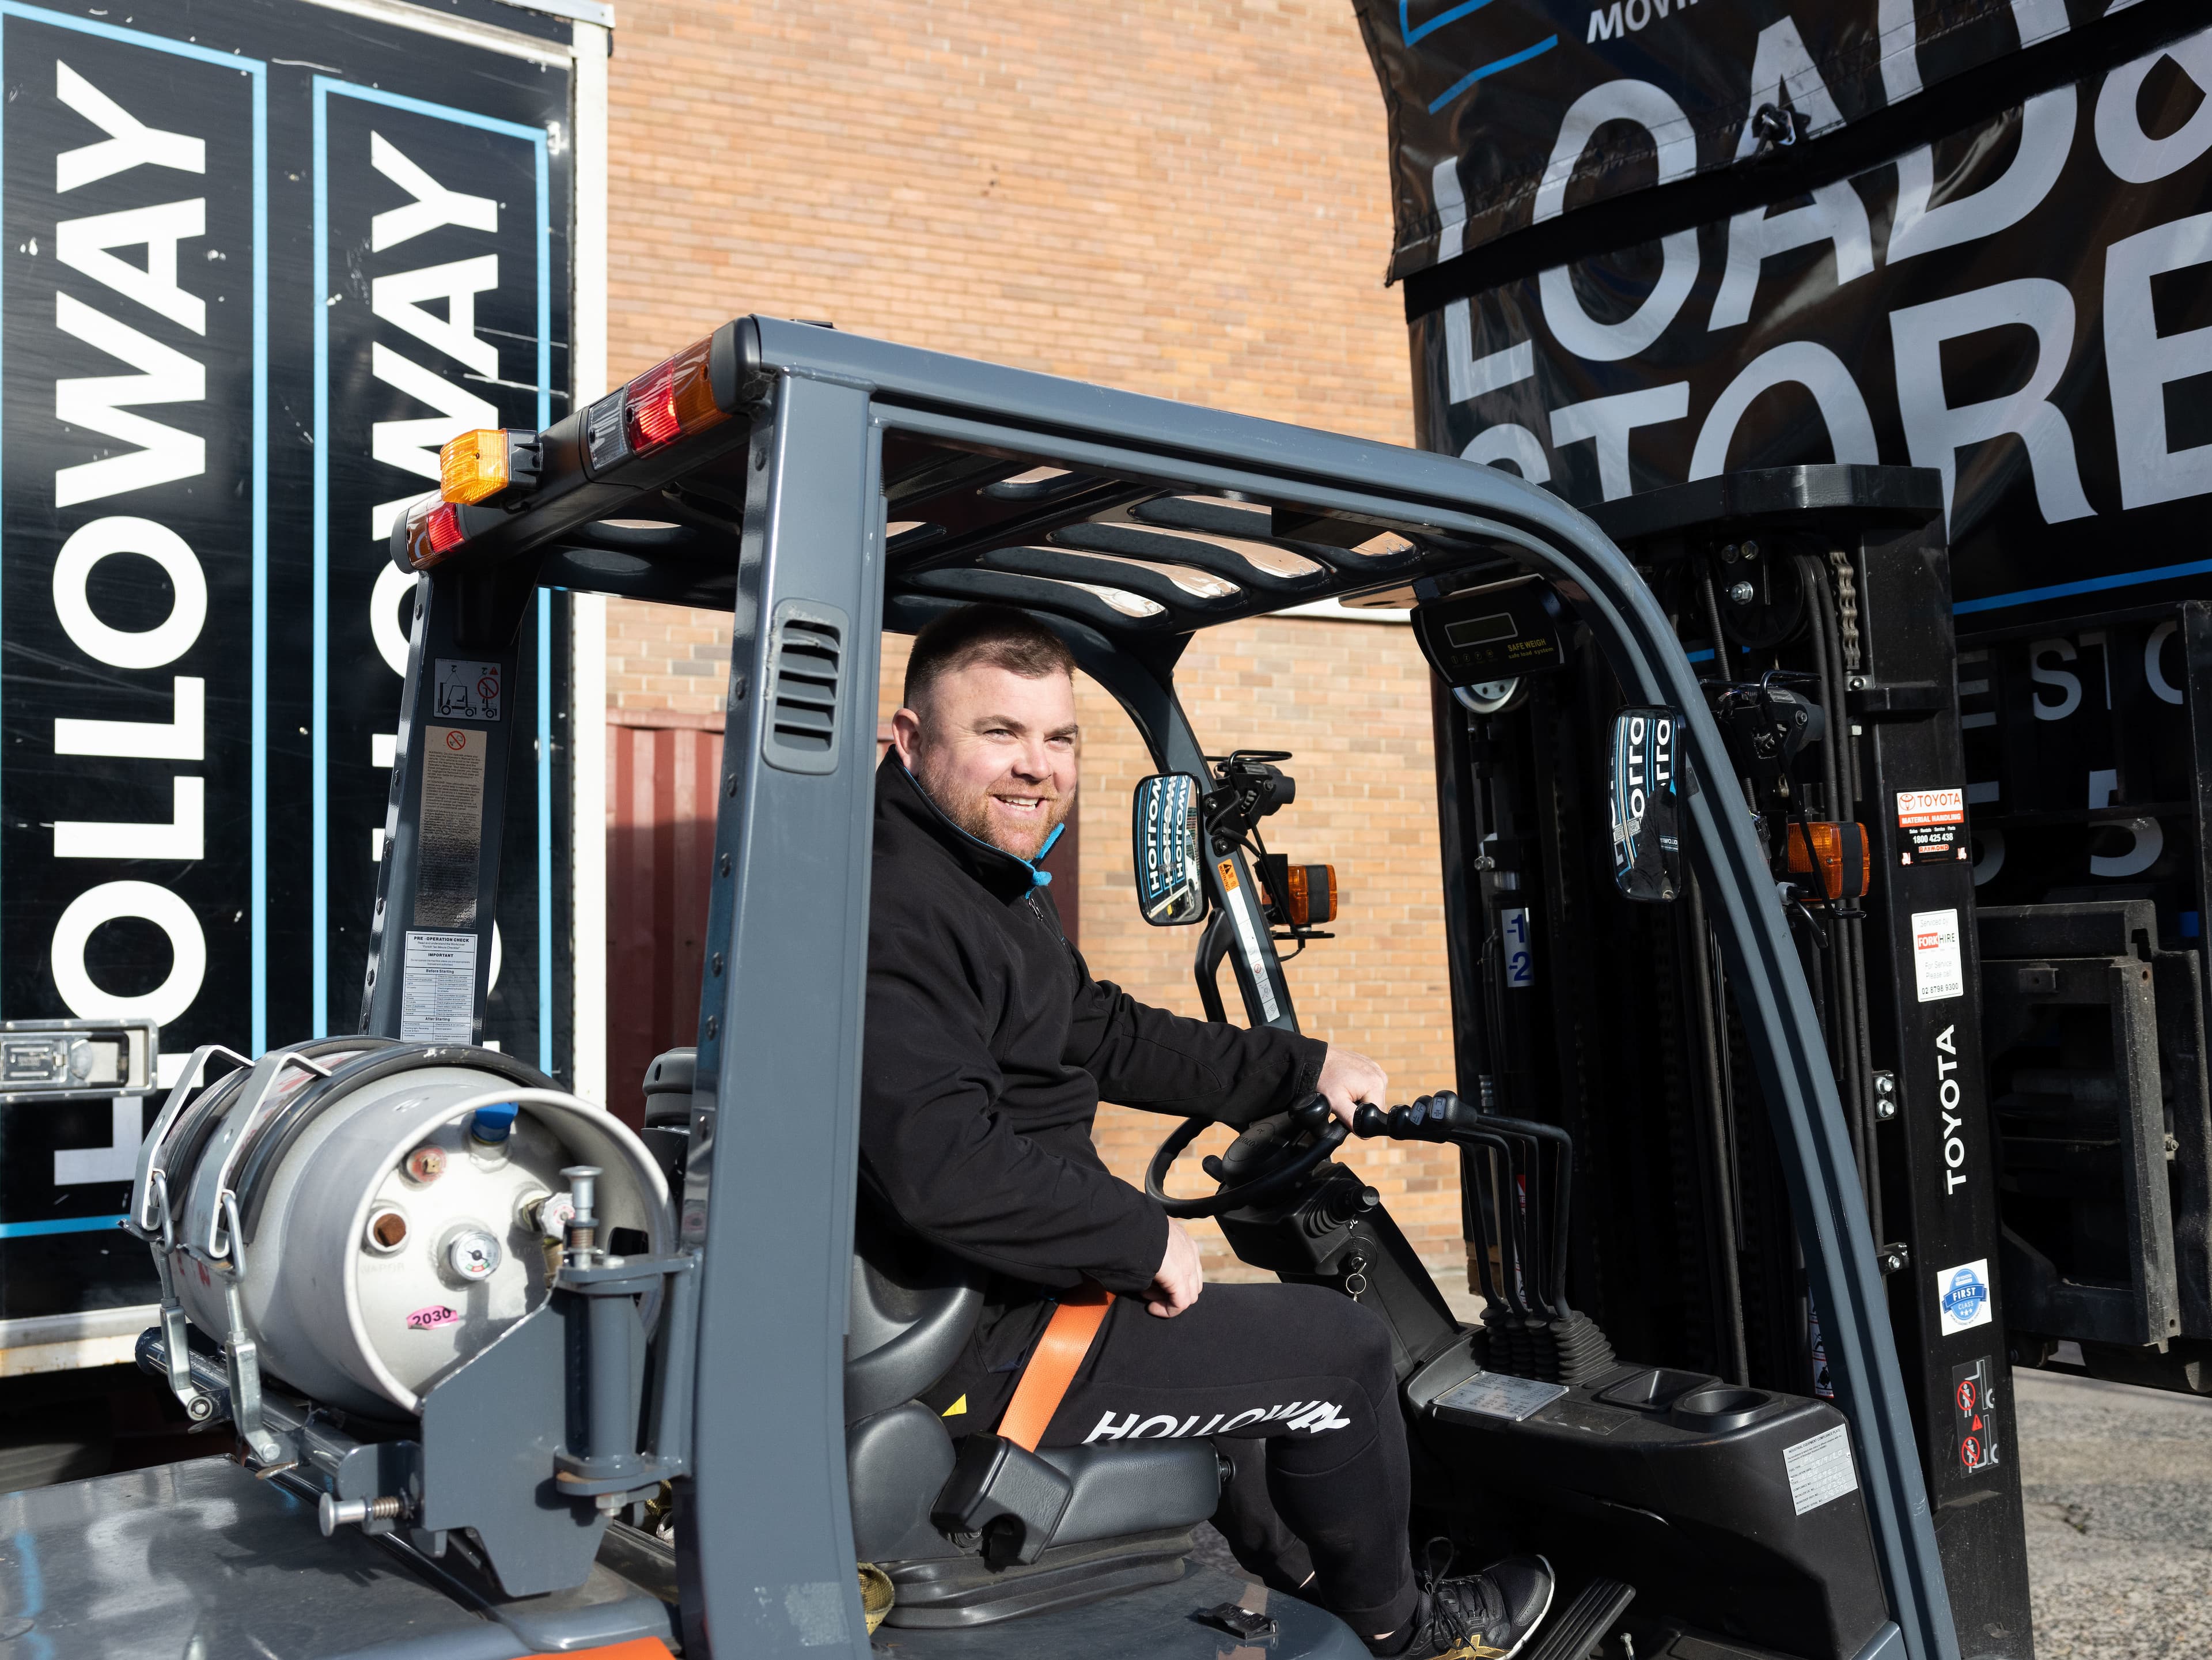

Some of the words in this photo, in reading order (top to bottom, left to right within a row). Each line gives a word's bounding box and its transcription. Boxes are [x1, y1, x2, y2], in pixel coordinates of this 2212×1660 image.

[1508, 642, 1524, 652] SAFE
[1525, 638, 1546, 648] WEIGH
[1535, 647, 1554, 655] system
[1918, 793, 1961, 807] TOYOTA
[1902, 816, 1931, 824] MATERIAL
[1913, 835, 1928, 844] 1800
[1929, 834, 1941, 842] 425
[1942, 833, 1953, 841] 438
[1219, 865, 1230, 891] WARNING
[1936, 1024, 1967, 1195] TOYOTA
[1953, 1287, 1976, 1301] FIRST
[1959, 1301, 1974, 1310] CLASS
[412, 1307, 451, 1325] 2030
[1802, 1438, 1817, 1447] EQUIPMENT
[1817, 1431, 1832, 1441] COMPLIANCE
